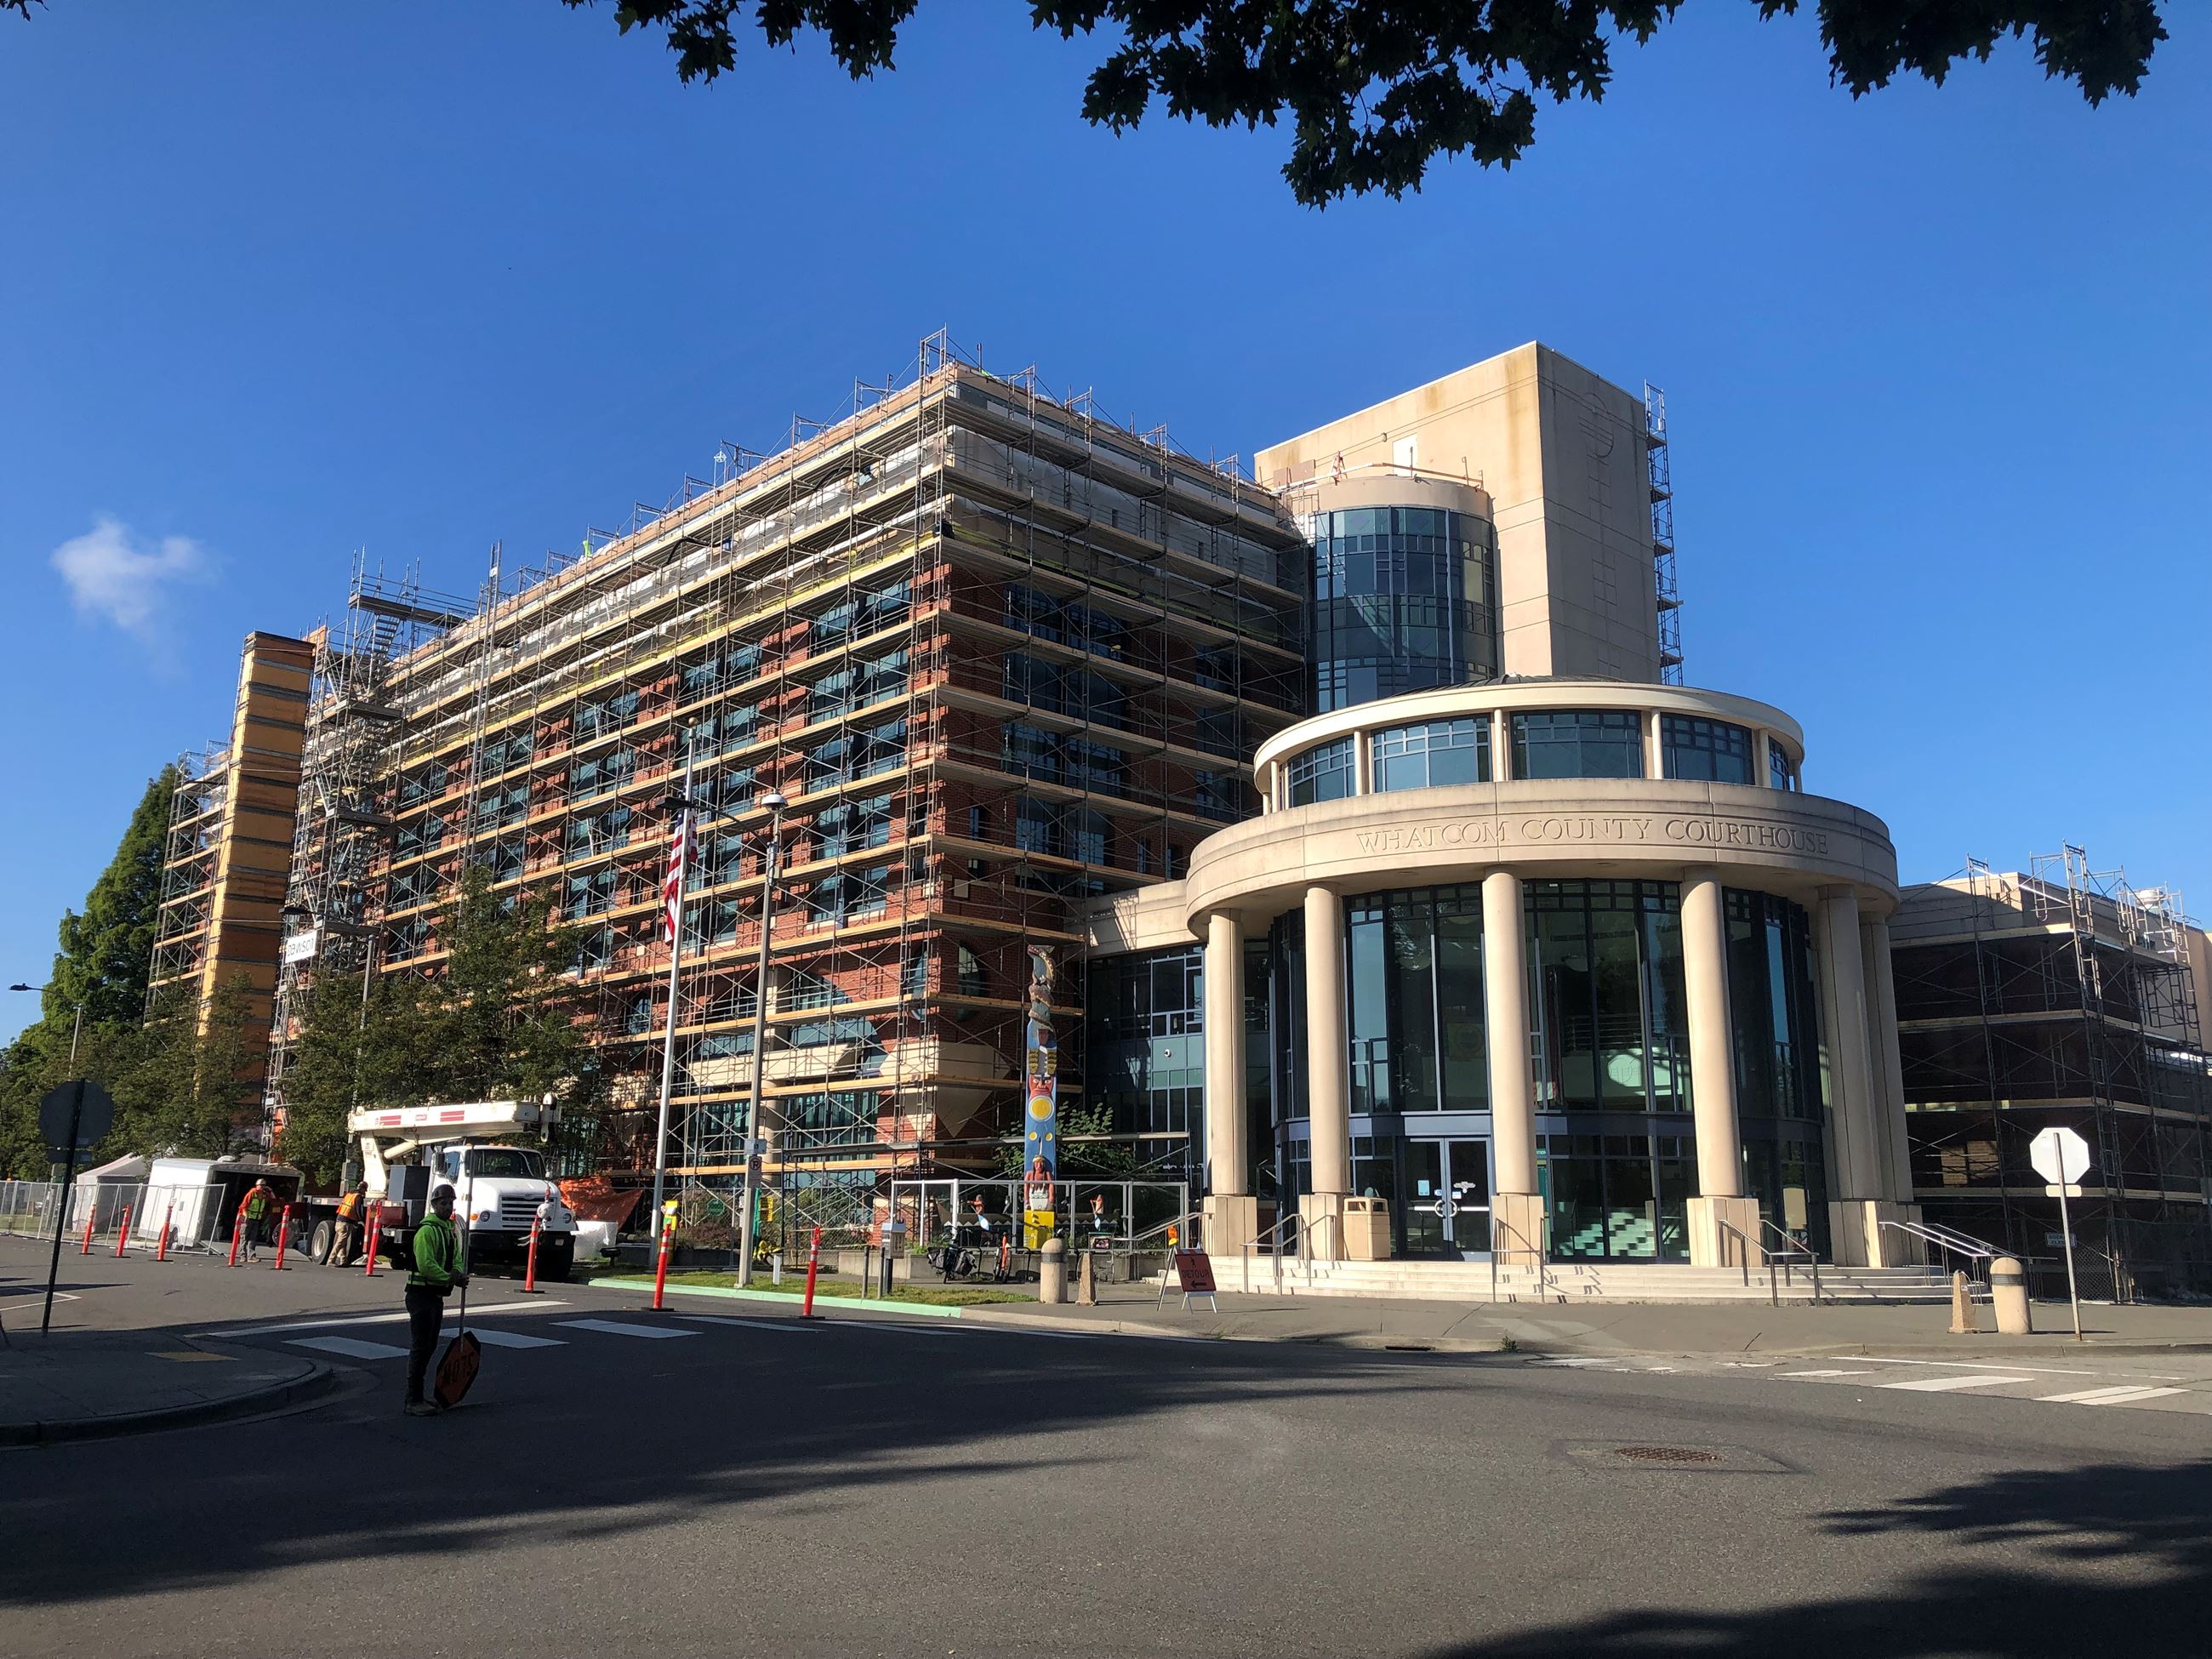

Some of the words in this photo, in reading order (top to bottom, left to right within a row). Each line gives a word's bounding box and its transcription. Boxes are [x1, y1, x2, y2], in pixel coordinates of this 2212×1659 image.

[1356, 820, 1510, 852] WHATCOM
[1521, 818, 1653, 840] COUNTY
[1665, 819, 1829, 854] COURTHOUSE
[1181, 1268, 1211, 1279] DETOUR
